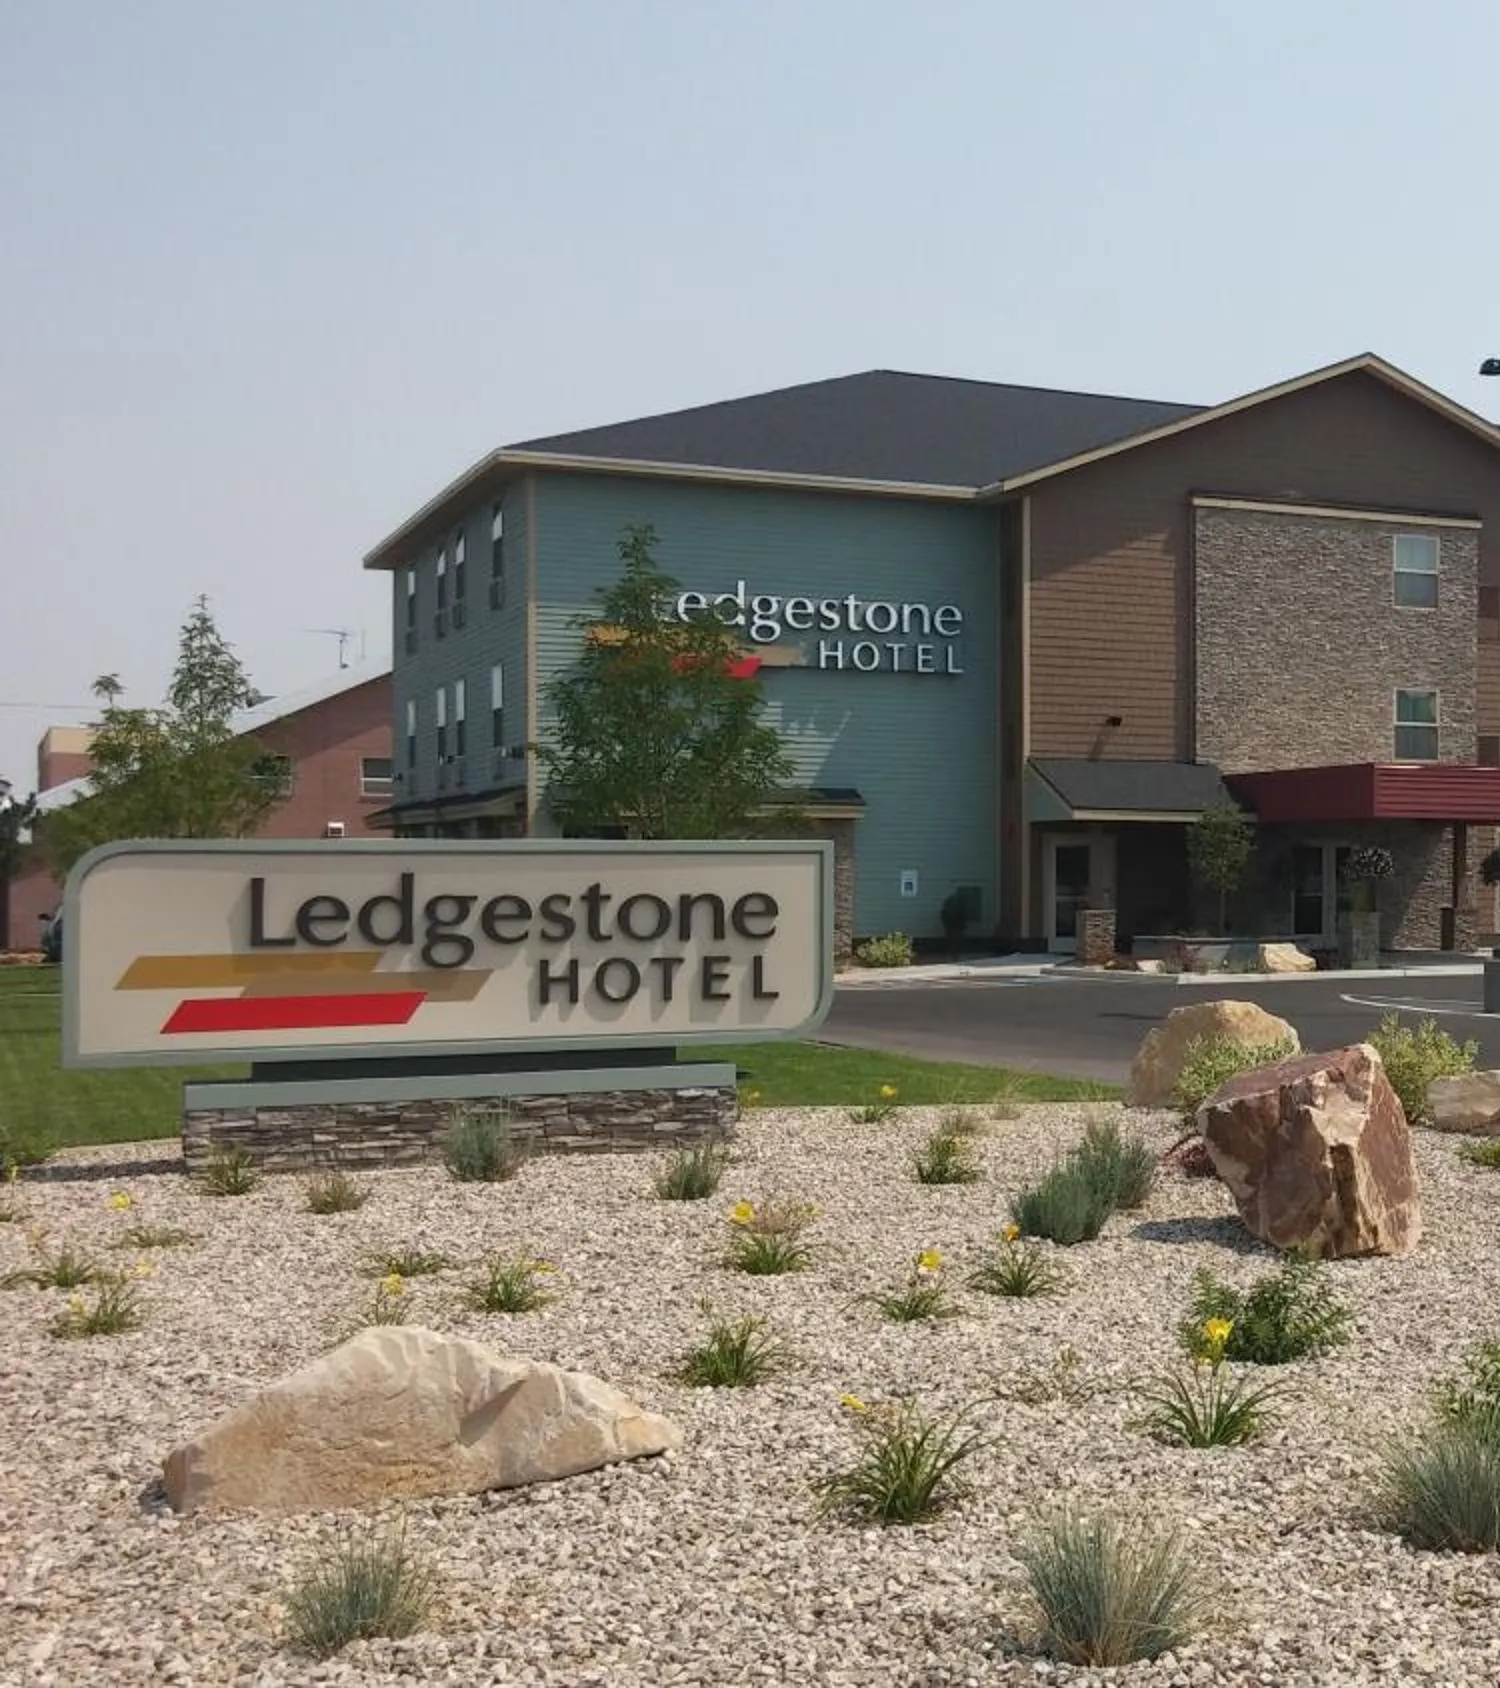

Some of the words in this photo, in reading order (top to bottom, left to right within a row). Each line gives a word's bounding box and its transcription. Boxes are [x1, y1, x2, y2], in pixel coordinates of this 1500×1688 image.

[818, 640, 964, 674] HOTEL
[249, 872, 780, 968] Ledgestone
[537, 955, 780, 1005] HOTEL
